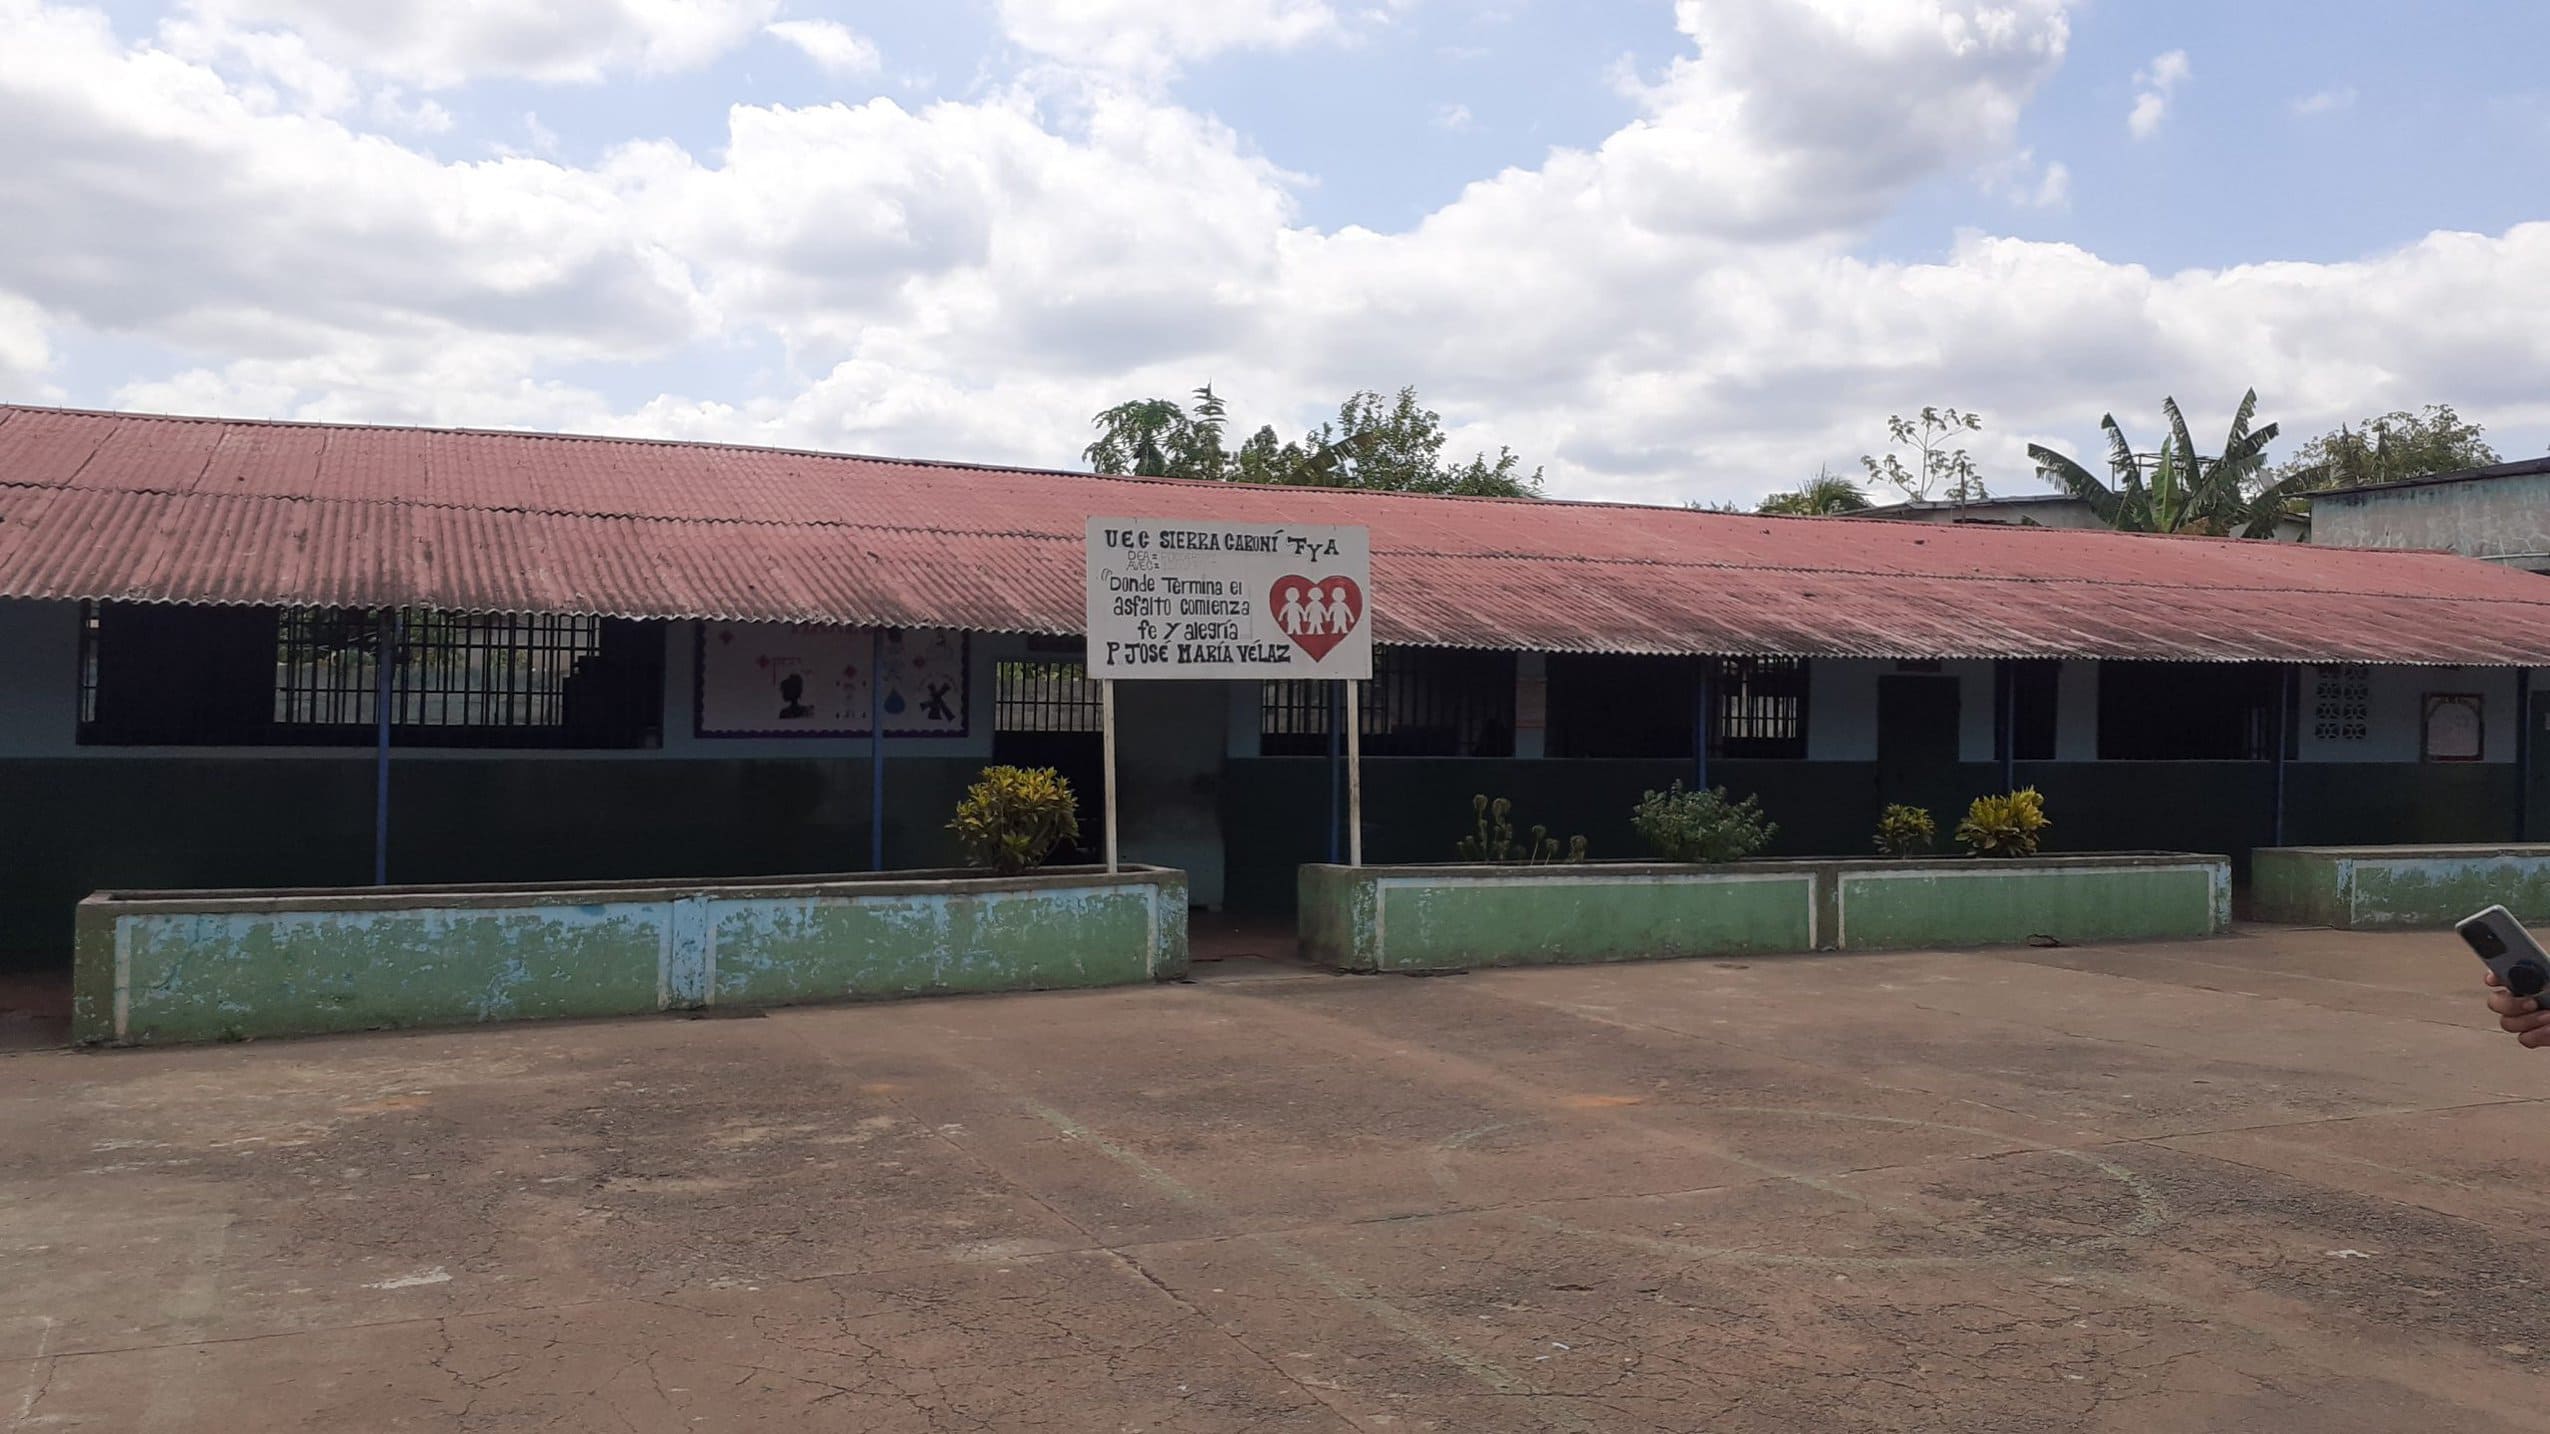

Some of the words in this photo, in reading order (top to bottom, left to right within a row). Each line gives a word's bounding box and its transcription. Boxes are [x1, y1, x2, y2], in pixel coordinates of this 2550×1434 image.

[1159, 530, 1221, 551] SIERRA
[1224, 529, 1285, 553] CARONÍ
[1161, 576, 1223, 595] Termina
[1113, 595, 1172, 617] asfalto
[1180, 600, 1250, 616] comienza
[1138, 619, 1158, 640] fe
[1184, 619, 1239, 641] alegría
[1106, 641, 1125, 666] P
[1124, 640, 1169, 665] JOSÉ
[1177, 640, 1235, 664] MARÍA
[1236, 639, 1292, 663] VÉLAZ
